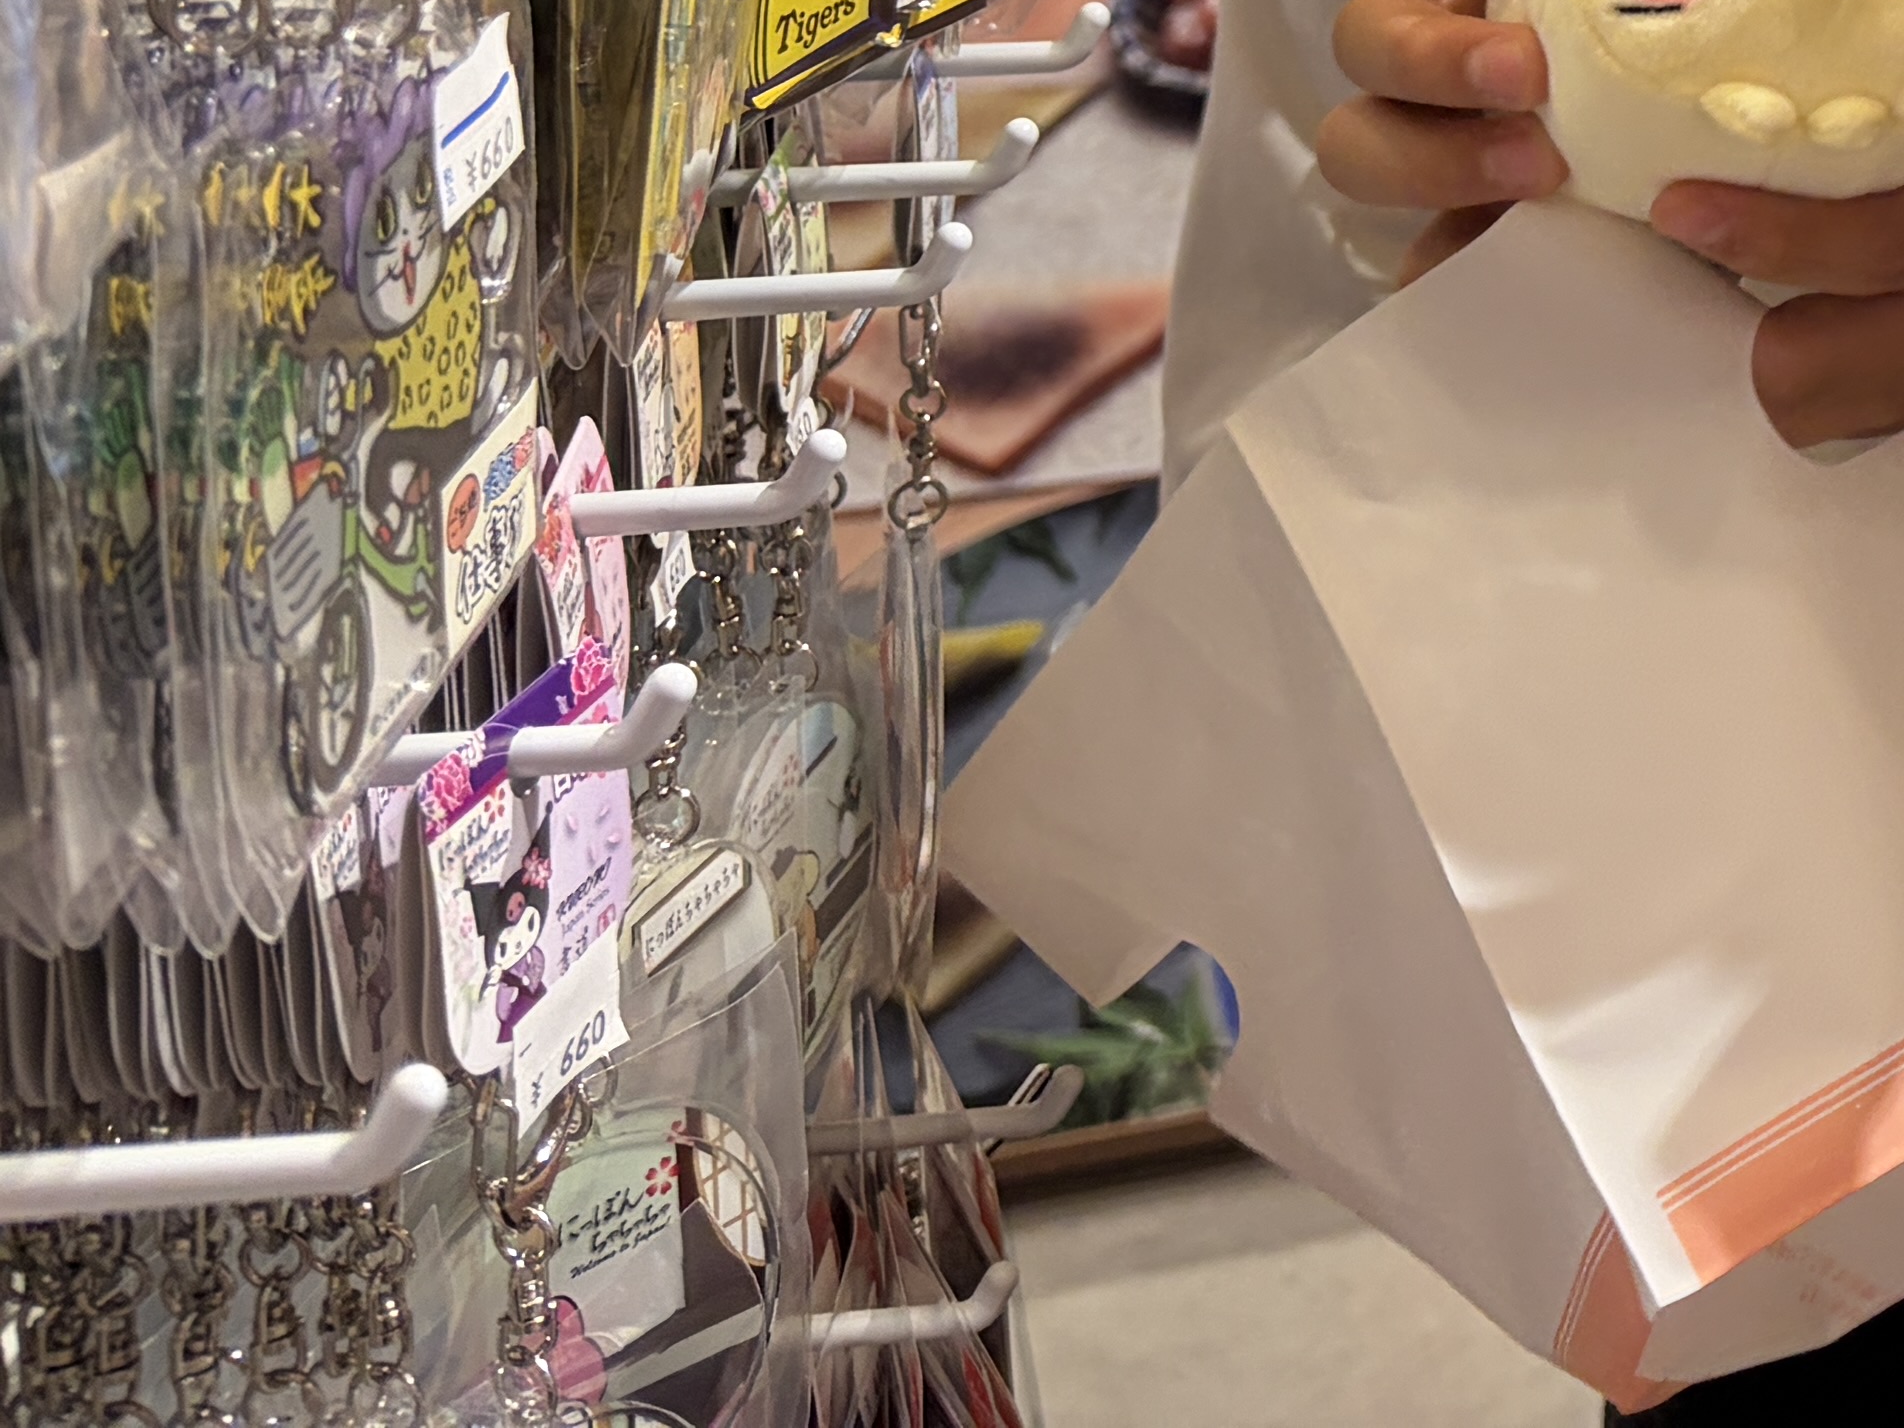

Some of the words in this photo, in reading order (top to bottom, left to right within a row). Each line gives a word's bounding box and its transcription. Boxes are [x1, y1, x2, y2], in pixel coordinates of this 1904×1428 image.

[464, 115, 515, 193] ¥660
[559, 1009, 606, 1077] 660
[557, 1186, 645, 1249] にっぽん
